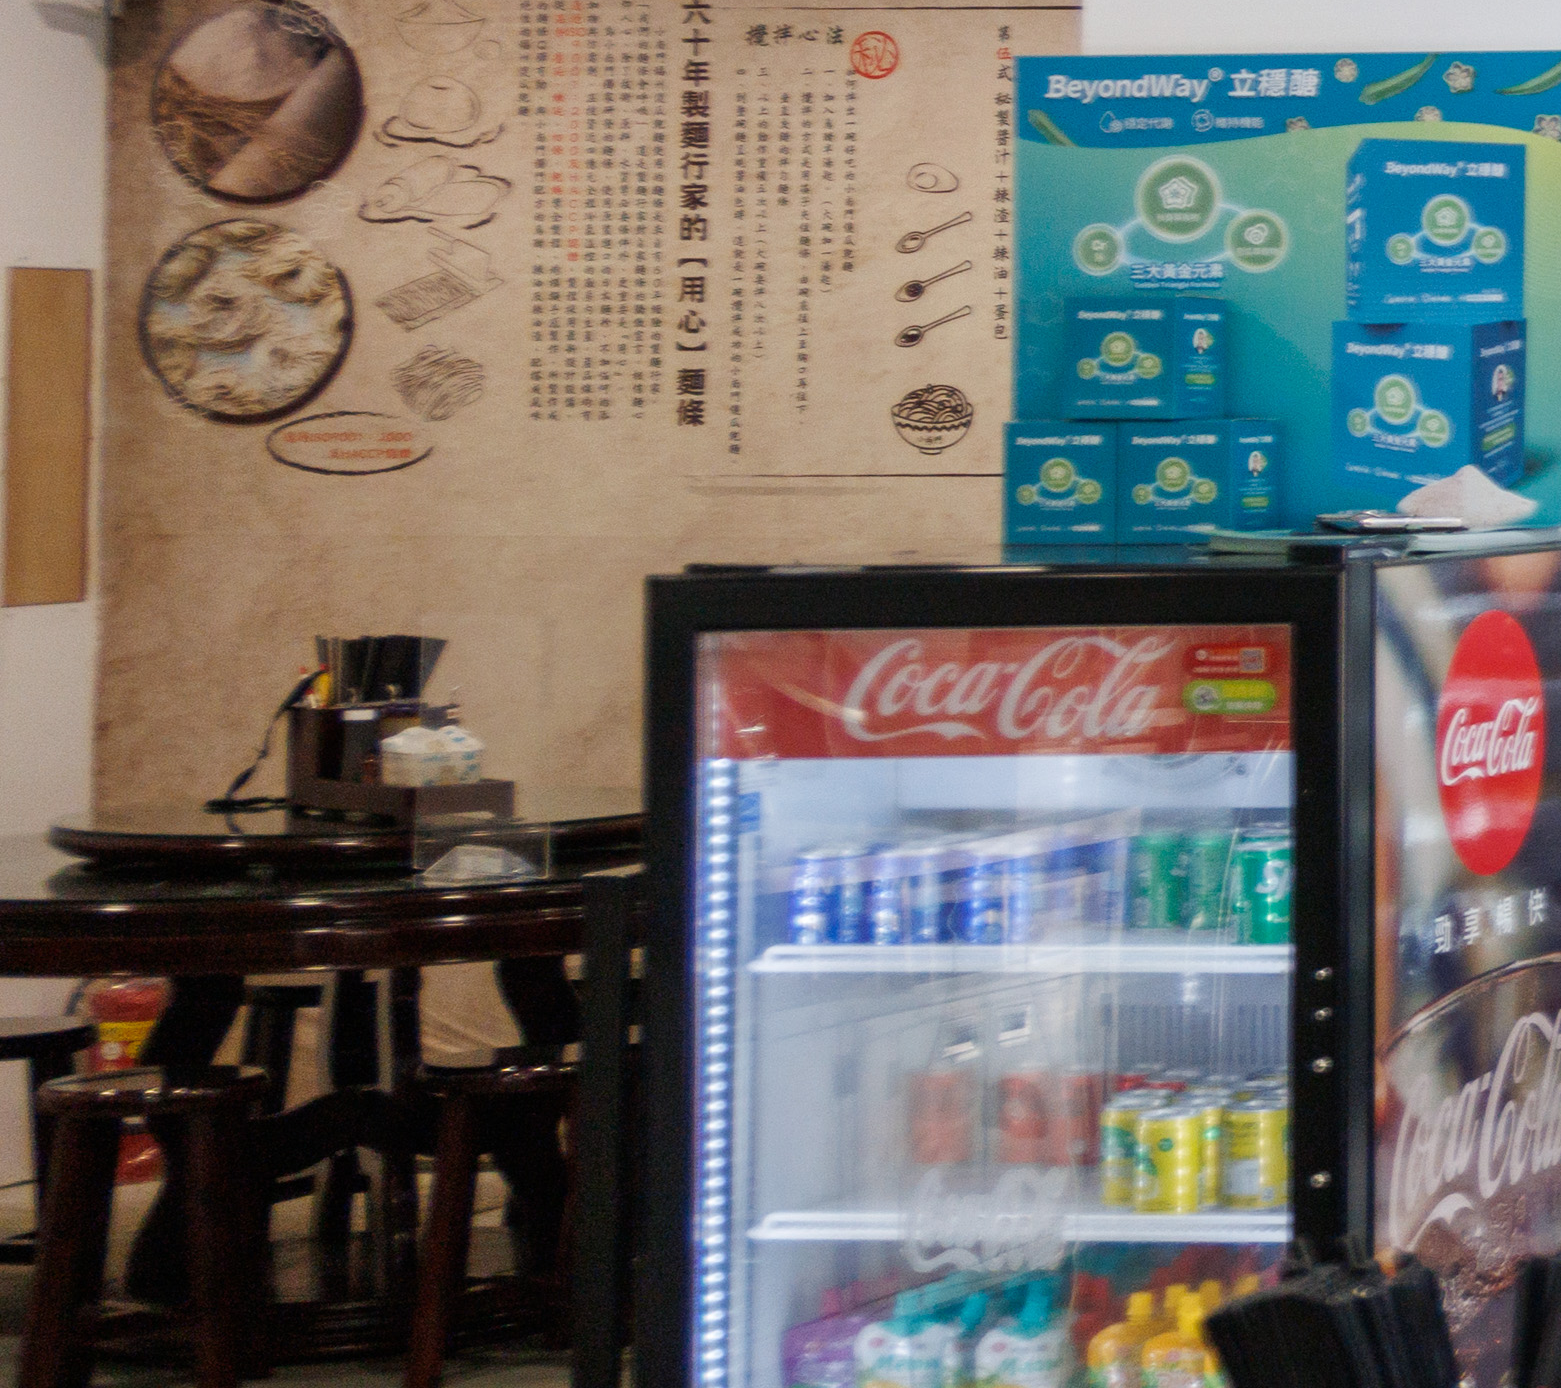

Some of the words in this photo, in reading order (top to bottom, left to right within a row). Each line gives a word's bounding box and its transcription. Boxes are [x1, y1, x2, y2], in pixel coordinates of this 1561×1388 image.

[746, 23, 845, 46] 攪拌心法
[676, 0, 712, 427] 六十年製麵行家的【用心】麵條
[844, 634, 1178, 743] Coca-Cola
[1440, 696, 1539, 787] Coca-Cola
